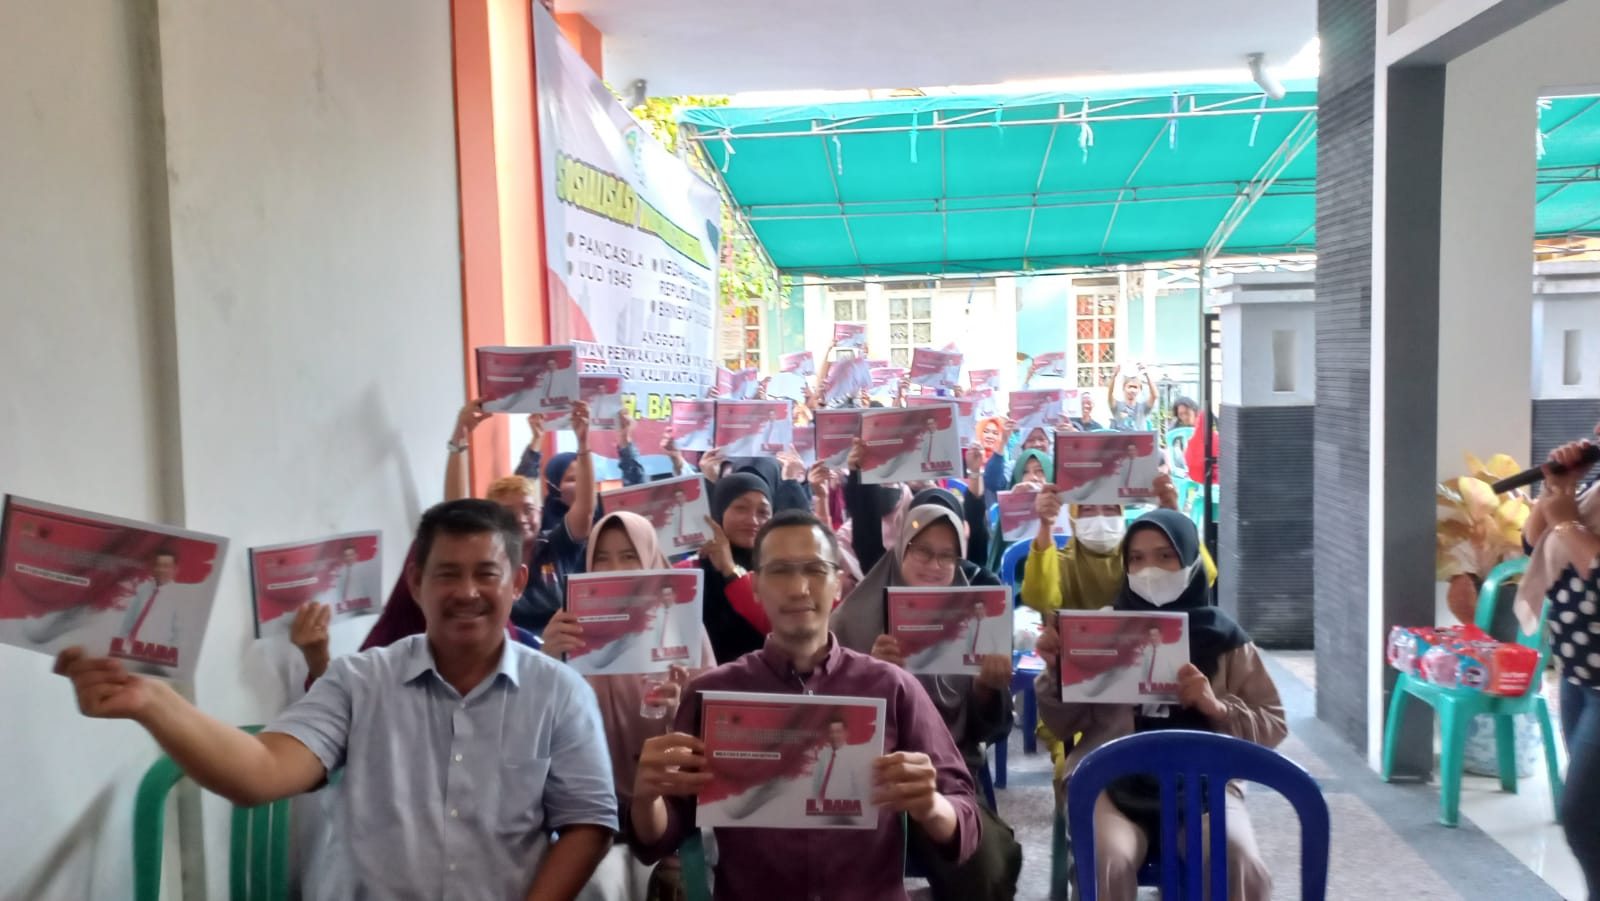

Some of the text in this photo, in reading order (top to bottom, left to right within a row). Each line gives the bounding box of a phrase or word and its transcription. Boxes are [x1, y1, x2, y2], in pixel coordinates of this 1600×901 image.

[556, 149, 638, 228] SOSIALISASI
[578, 233, 645, 268] PANCASILA
[578, 261, 632, 289] UUD 1945
[641, 331, 687, 347] ANGGOTA
[607, 345, 673, 365] PERWAKILAN
